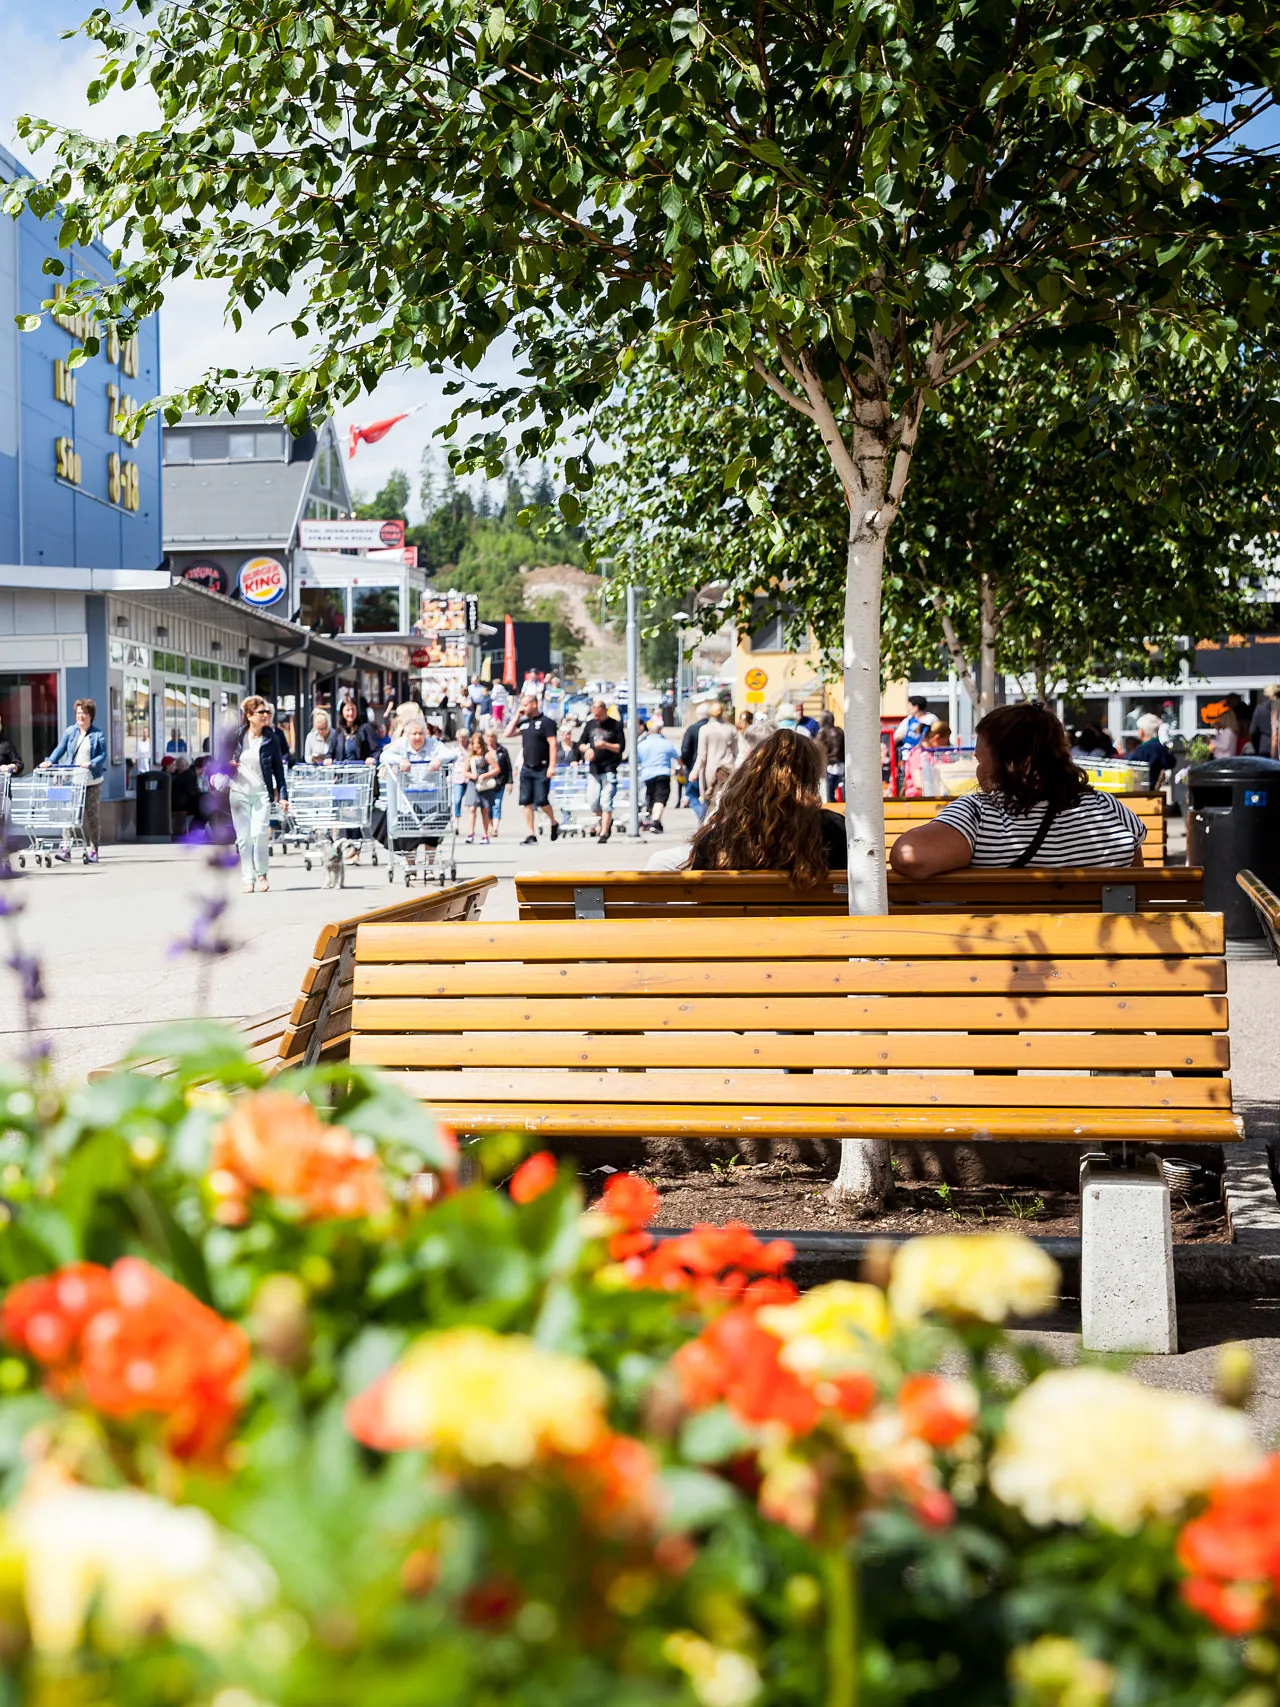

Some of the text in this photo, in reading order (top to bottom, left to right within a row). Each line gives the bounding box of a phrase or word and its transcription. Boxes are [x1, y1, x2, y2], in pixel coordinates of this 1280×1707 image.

[109, 452, 139, 511] 8-18
[242, 565, 280, 583] BURGER
[244, 573, 281, 595] KING
